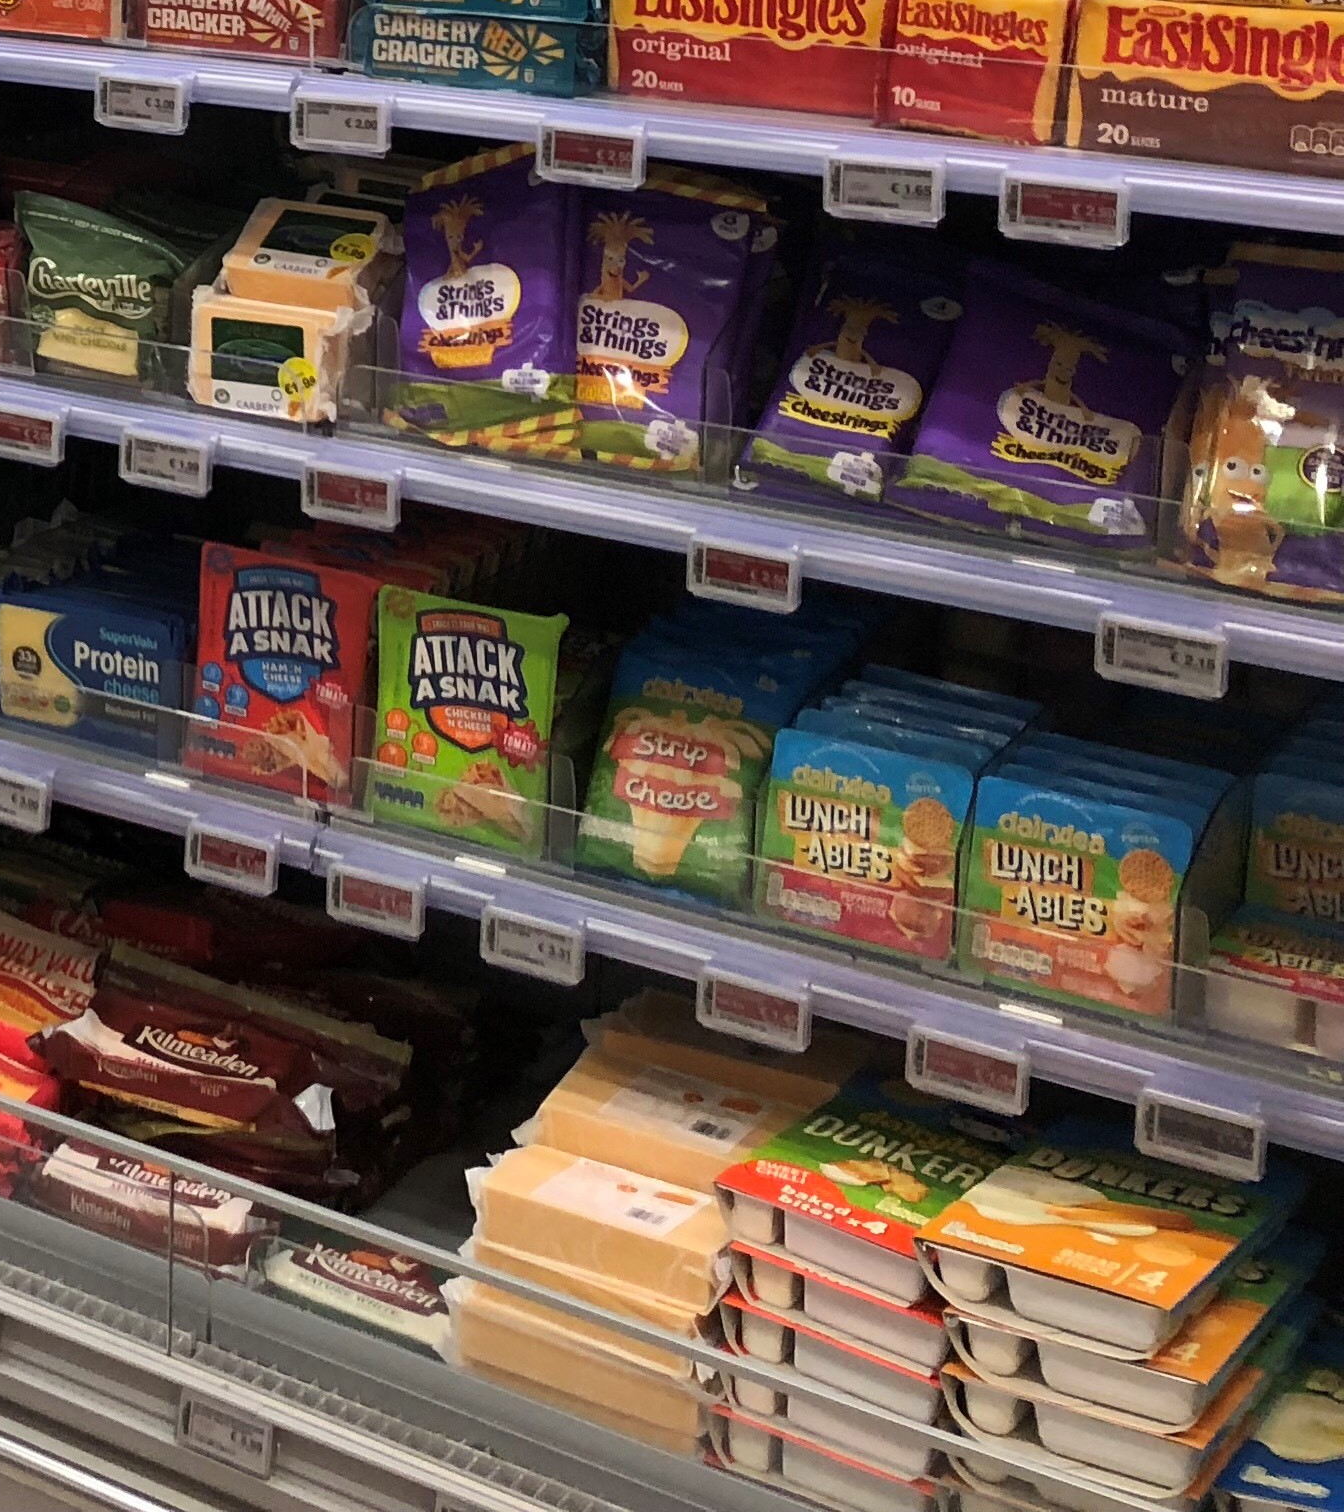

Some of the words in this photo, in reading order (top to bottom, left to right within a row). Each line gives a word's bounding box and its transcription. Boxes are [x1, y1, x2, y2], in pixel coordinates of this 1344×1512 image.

[634, 36, 731, 61] original
[634, 70, 659, 90] 20
[891, 86, 915, 106] 10
[1100, 84, 1209, 112] mature
[1097, 123, 1129, 144] 20
[30, 257, 152, 318] Charleville
[437, 279, 495, 305] Strings
[581, 306, 660, 338] Strings
[581, 327, 667, 358] &Things
[236, 399, 280, 413] CARBERY
[230, 590, 333, 638] ATTACK
[76, 642, 158, 682] Protein
[230, 633, 246, 655] A
[253, 632, 333, 663] SNAK
[414, 636, 520, 686] ATTACK
[416, 680, 434, 700] A
[441, 679, 520, 710] SNAK
[634, 733, 707, 761] Strip
[625, 777, 718, 808] Cheese
[784, 794, 870, 839] LUNCH
[990, 842, 1083, 889] LUNCH
[138, 1025, 260, 1077] Kilmeaden
[307, 1242, 439, 1308] Kilmeaden
